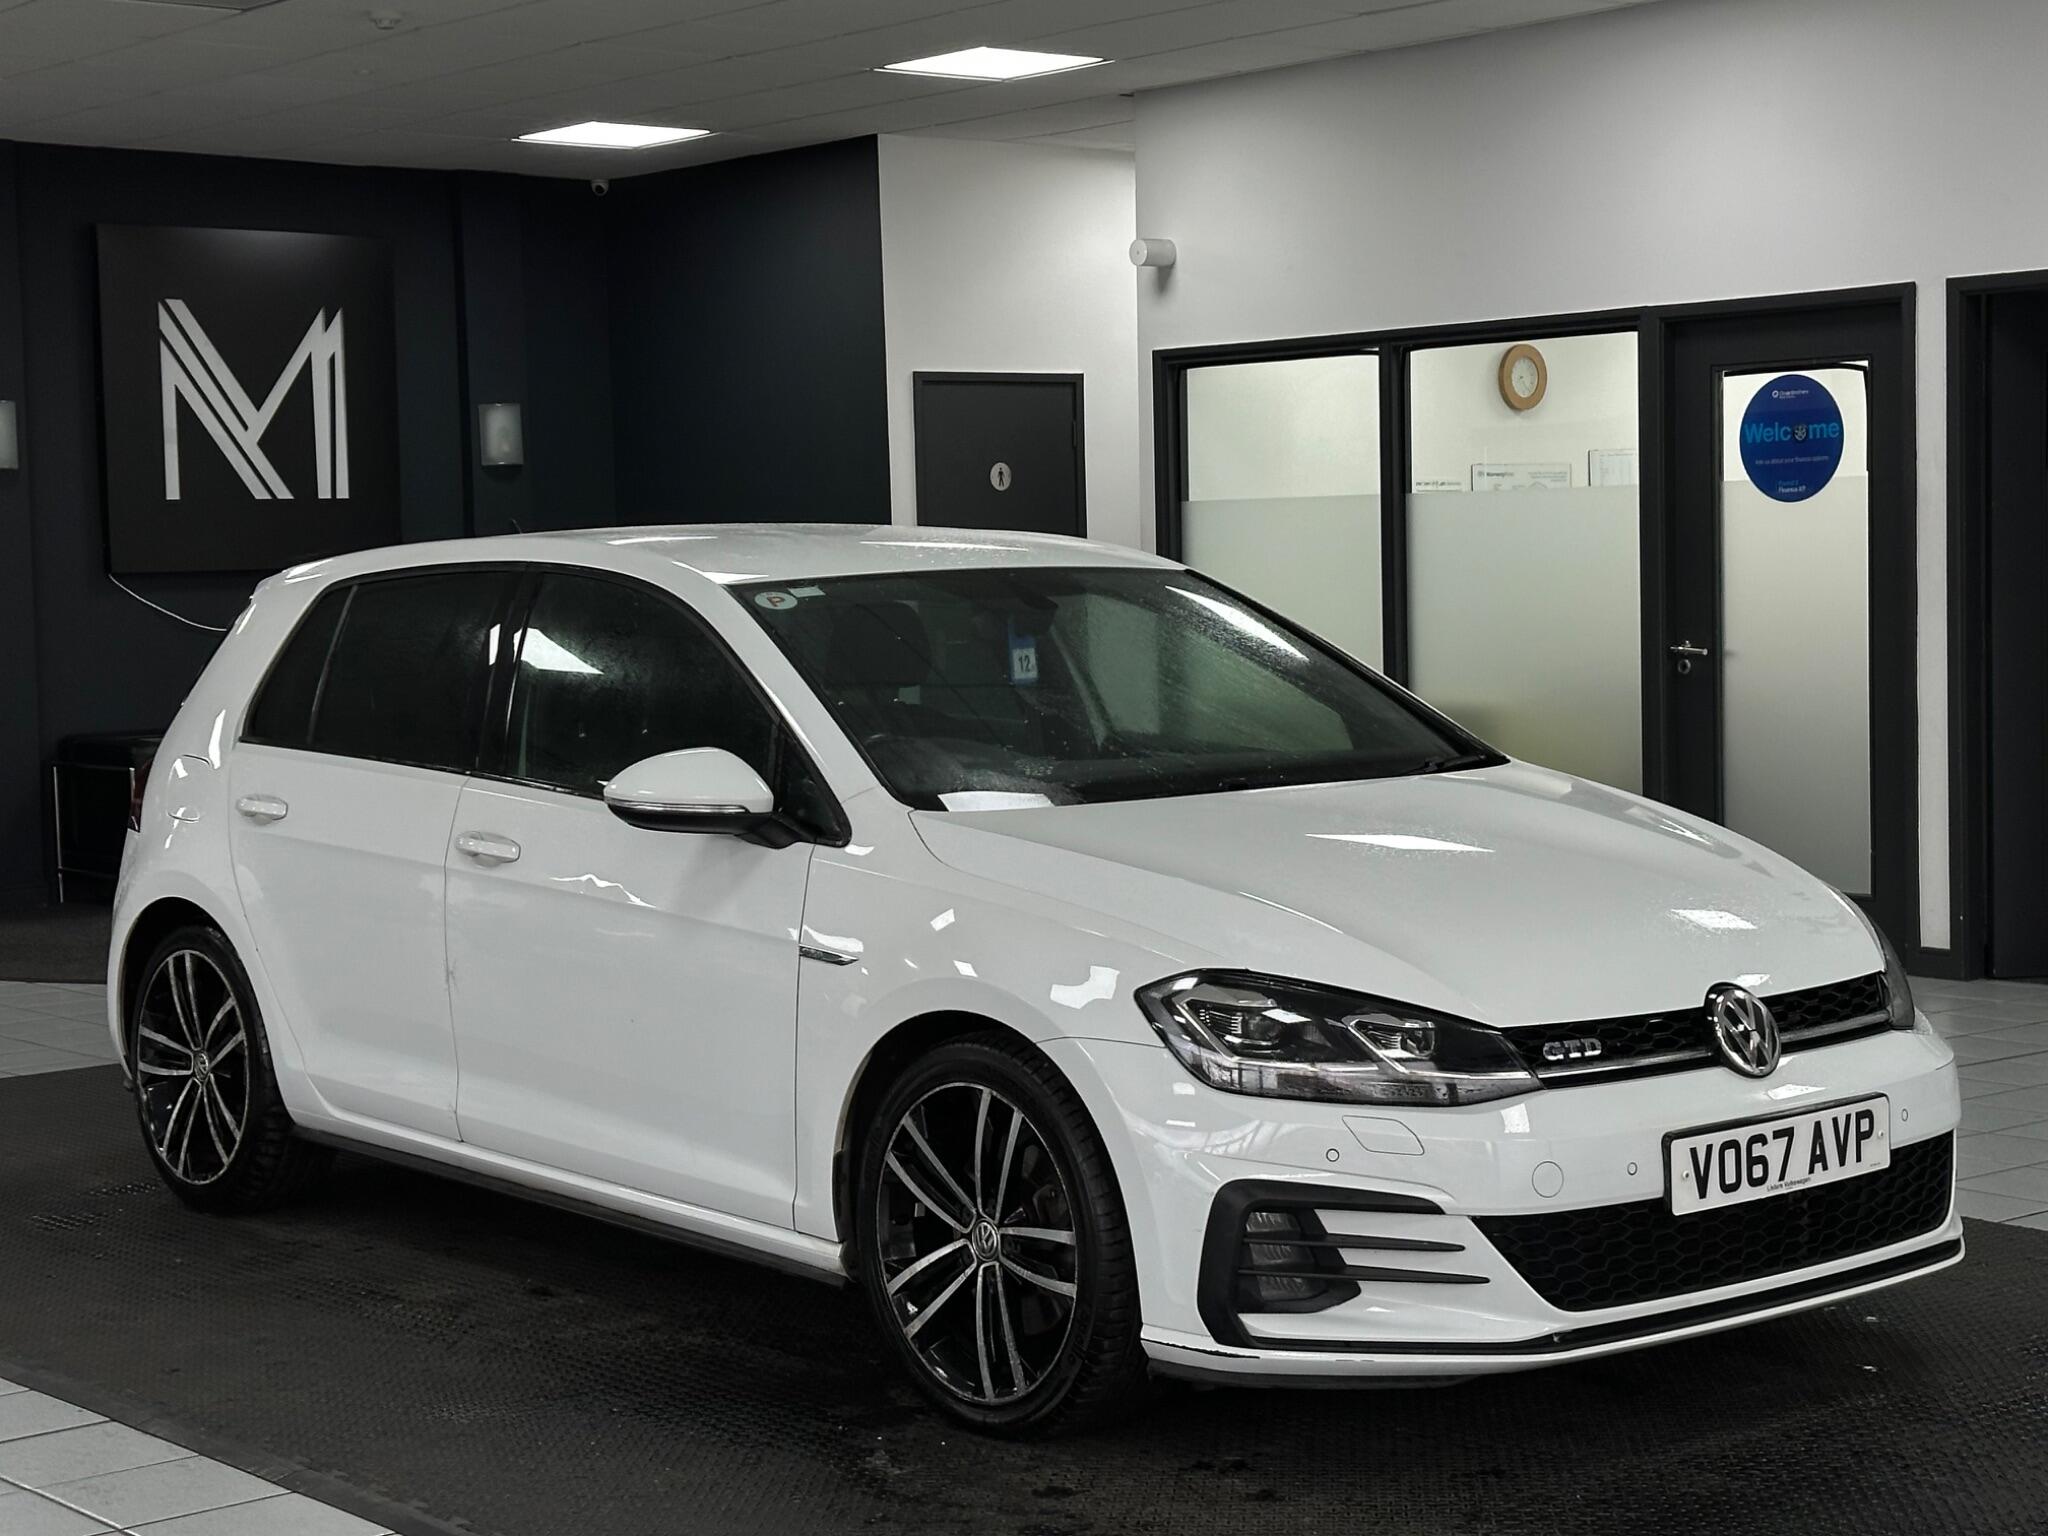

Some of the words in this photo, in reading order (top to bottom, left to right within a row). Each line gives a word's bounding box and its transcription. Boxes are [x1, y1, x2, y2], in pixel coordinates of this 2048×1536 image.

[1018, 654, 1030, 673] 12
[1543, 1038, 1601, 1060] GTD
[1689, 1127, 1794, 1200] VO67
[1808, 1109, 1875, 1175] AVP
